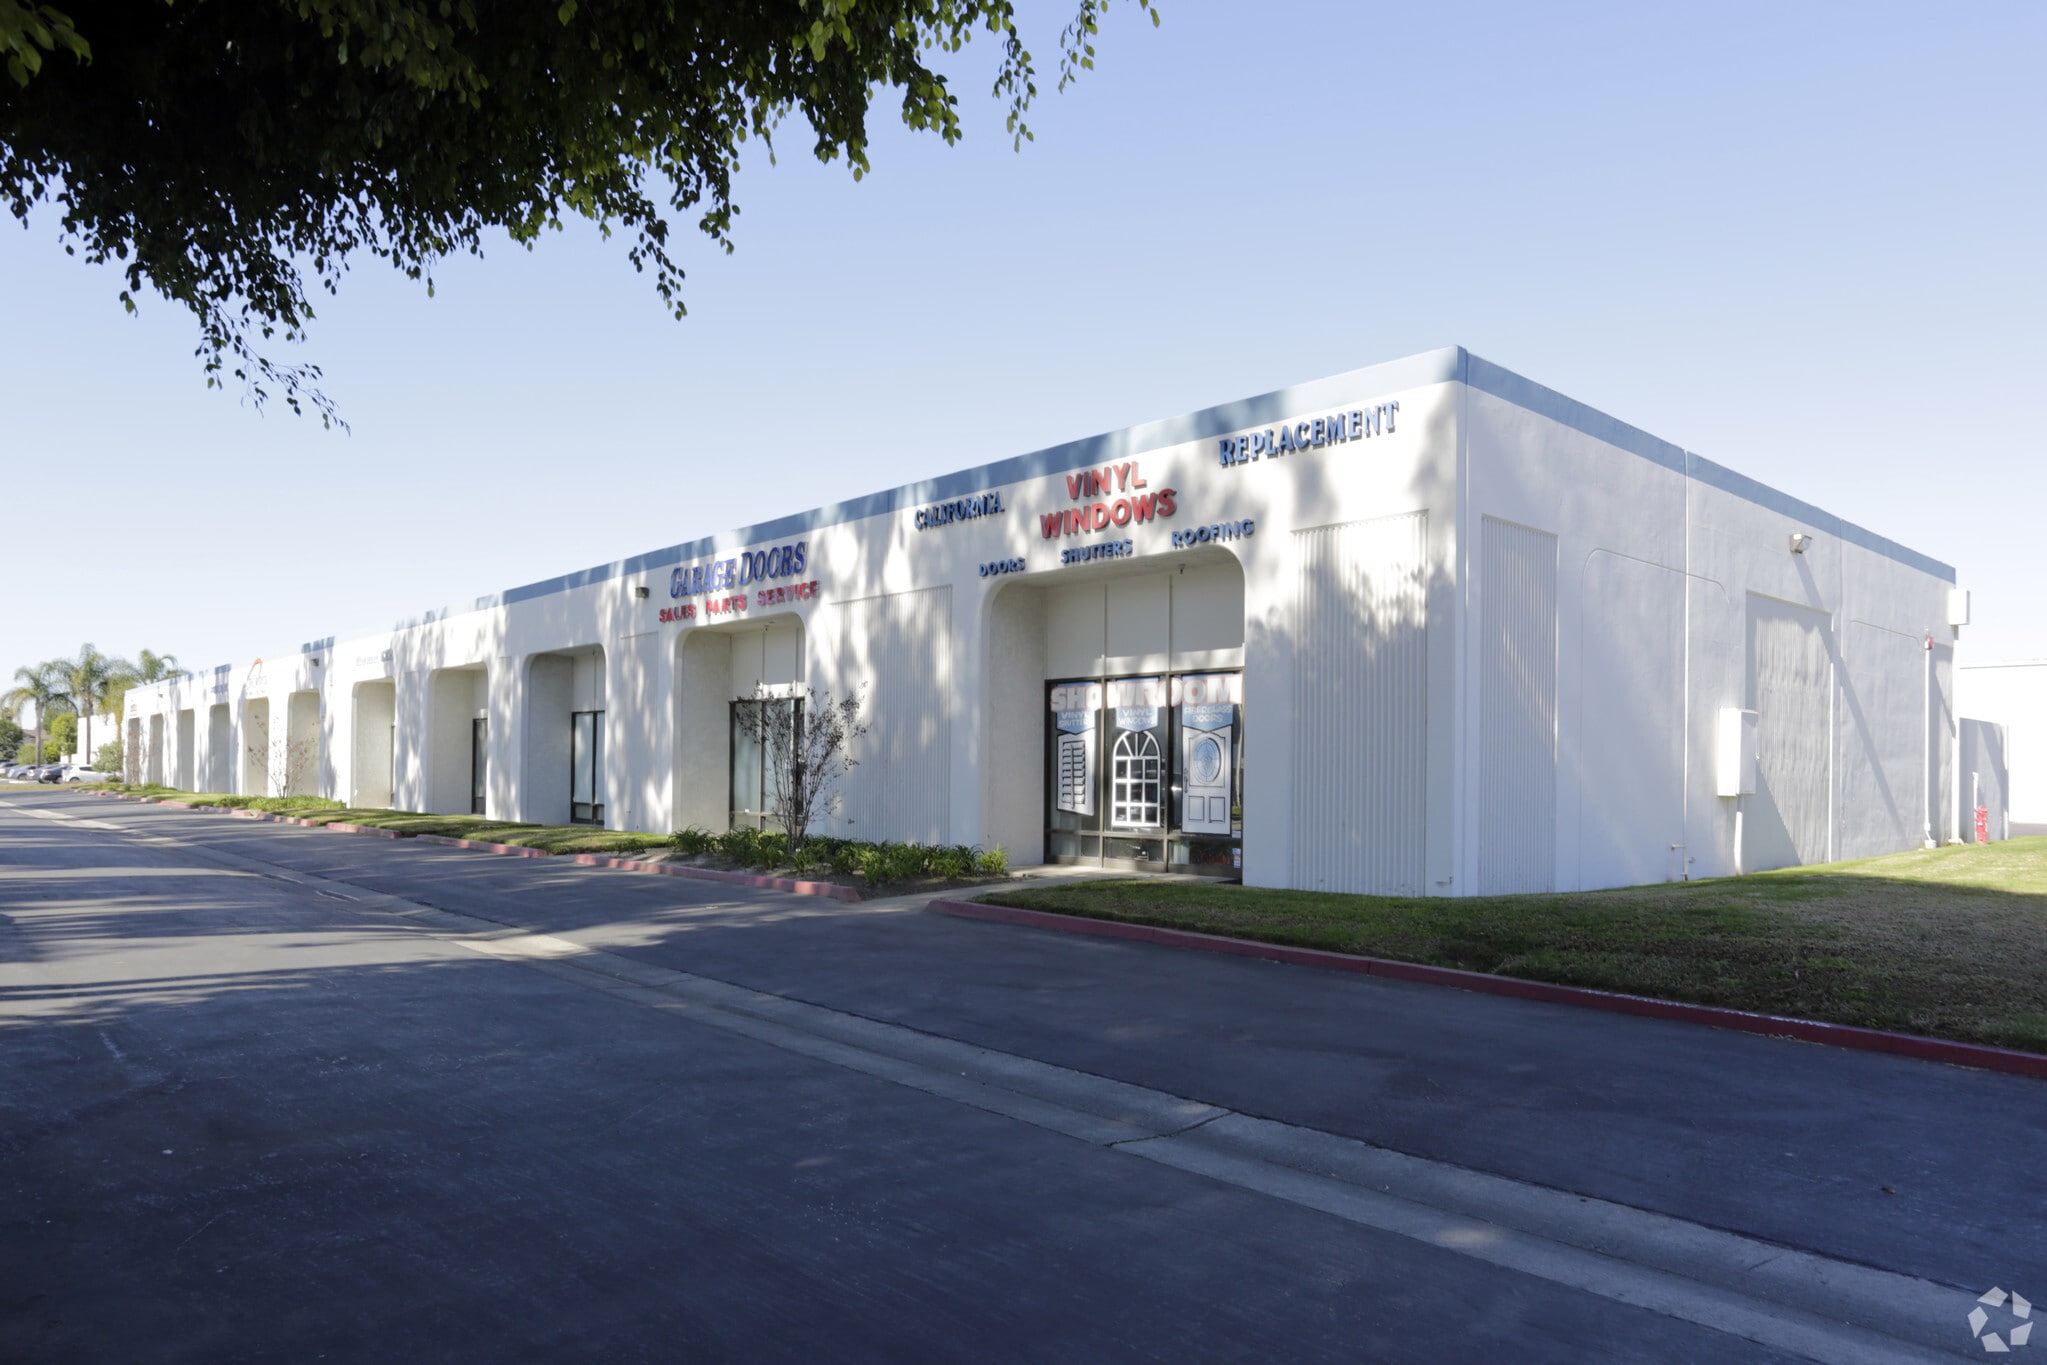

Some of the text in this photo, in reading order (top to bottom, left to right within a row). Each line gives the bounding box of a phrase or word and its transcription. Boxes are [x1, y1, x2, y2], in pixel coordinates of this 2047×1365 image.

[1219, 400, 1399, 467] REPLACEMENT
[1066, 461, 1147, 500] VINYL
[914, 491, 1004, 531] CALIFORNIA
[1040, 488, 1177, 539] WINDOWS
[978, 518, 1254, 578] DOORS SHUTTERS ROOFING
[670, 542, 807, 599] GARAGE DOORS
[659, 580, 820, 623] SALES PARTS SERVICE
[1049, 674, 1243, 713] SHOWROOM
[1122, 708, 1153, 717] VINYL
[1061, 710, 1089, 720] VINYL
